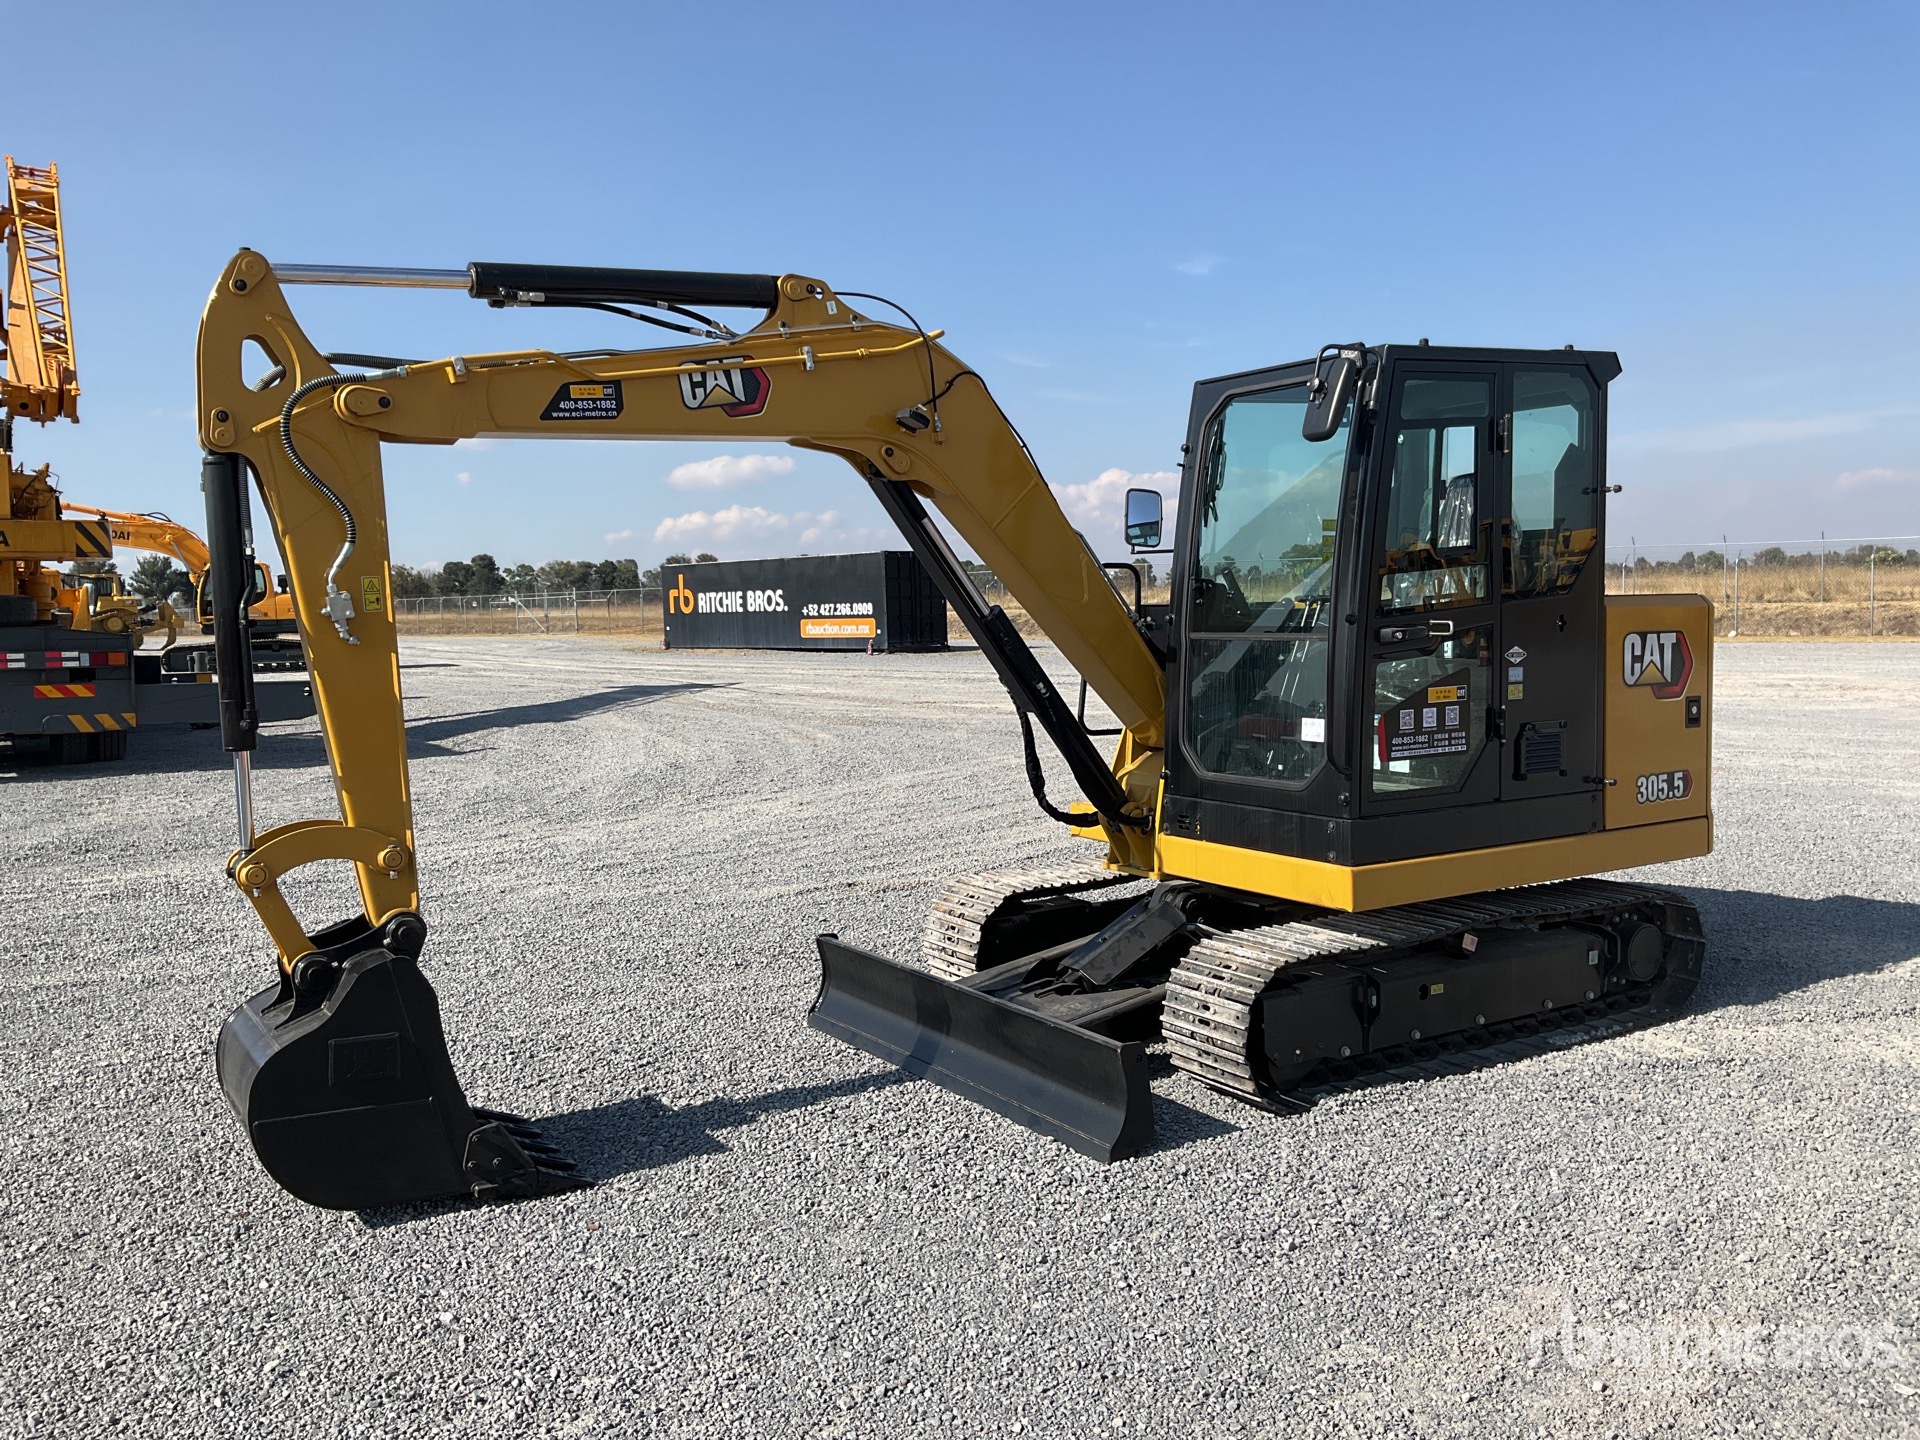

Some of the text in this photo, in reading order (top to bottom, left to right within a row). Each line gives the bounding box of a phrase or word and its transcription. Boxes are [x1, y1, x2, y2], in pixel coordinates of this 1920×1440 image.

[679, 357, 747, 408] CAT
[559, 400, 617, 409] 400-853-1882
[669, 574, 695, 614] rb
[698, 589, 788, 613] RITCHIE BROS.
[802, 602, 873, 616] +52 427.266.0909
[806, 622, 870, 635] rbauction.com.mx
[1624, 632, 1677, 686] CAT
[1392, 735, 1428, 744] 400-853-1882
[1637, 772, 1684, 804] 305.5
